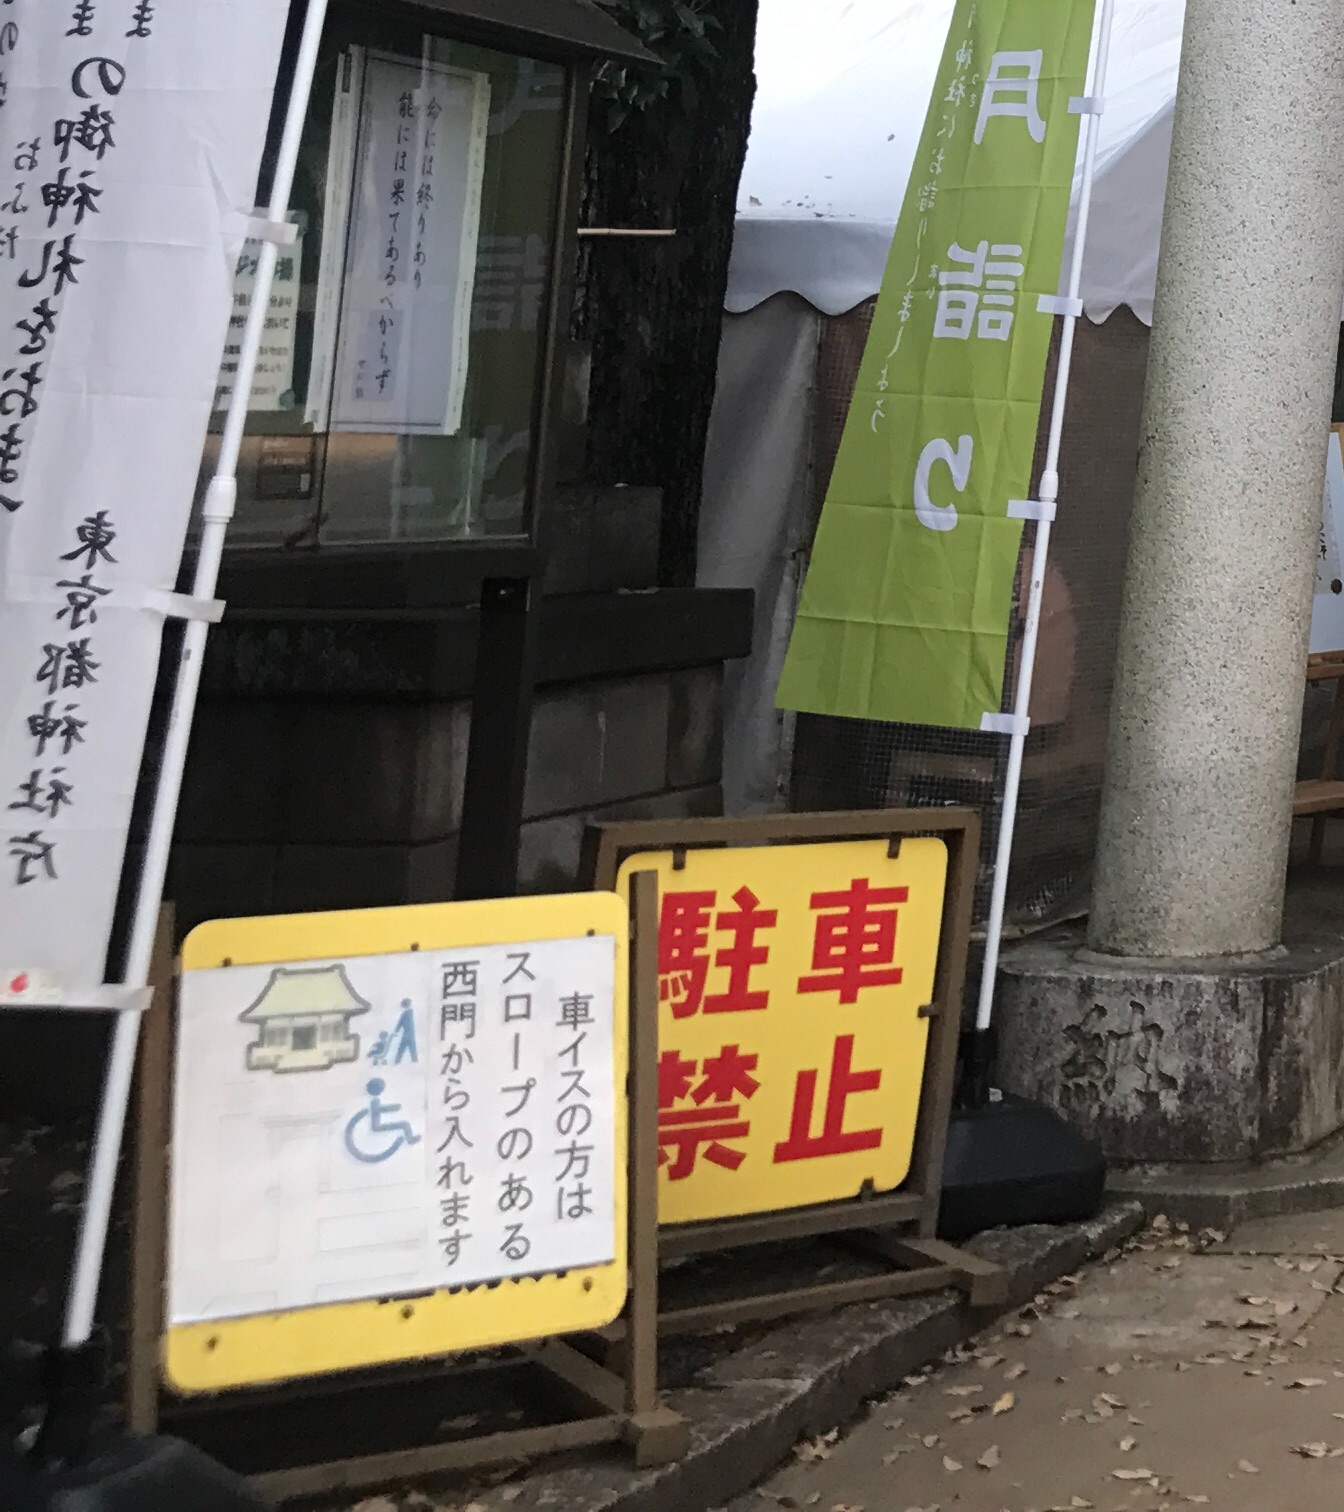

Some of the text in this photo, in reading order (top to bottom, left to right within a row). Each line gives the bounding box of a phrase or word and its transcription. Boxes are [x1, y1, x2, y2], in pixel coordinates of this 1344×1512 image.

[437, 960, 481, 1266] 西門から入れます
[496, 952, 537, 1262] スロープのある
[554, 991, 597, 1219] 車イスの方は
[656, 1034, 884, 1181] 禁止
